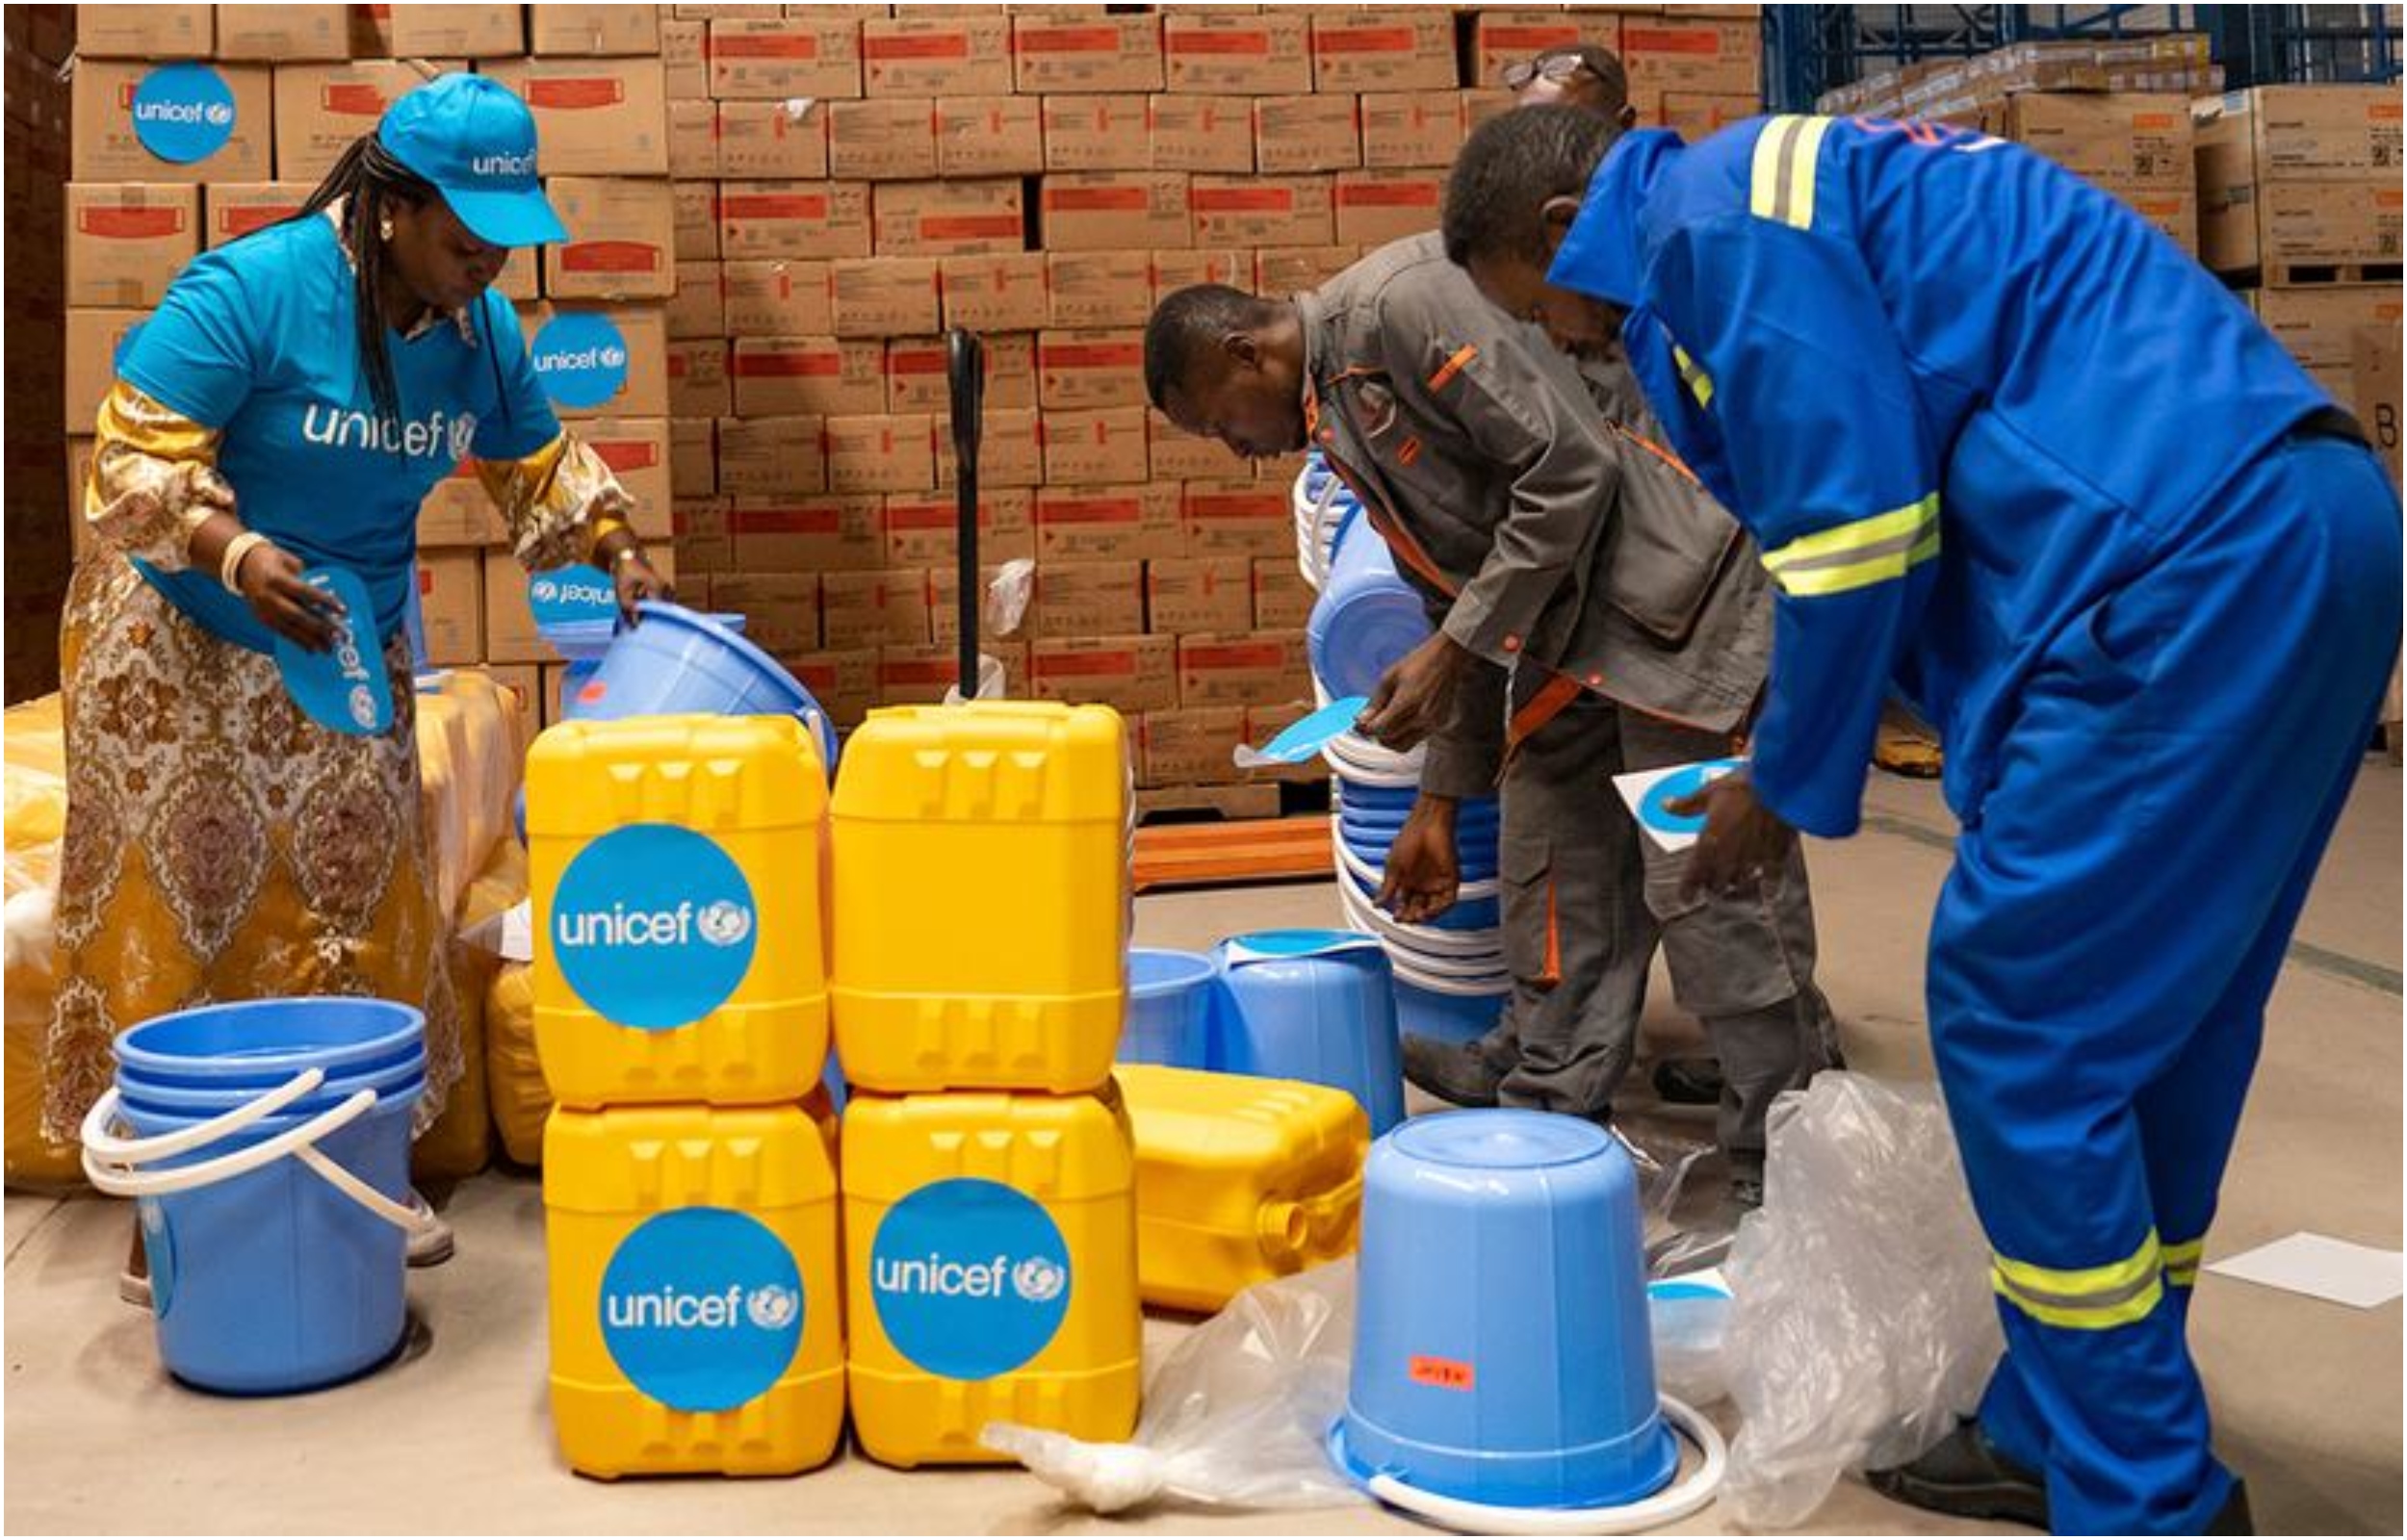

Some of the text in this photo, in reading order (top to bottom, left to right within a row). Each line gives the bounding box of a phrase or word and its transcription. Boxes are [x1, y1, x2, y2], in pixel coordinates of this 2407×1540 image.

[136, 99, 203, 123] unicef
[533, 346, 596, 372] unicef
[303, 403, 443, 459] unicef
[558, 901, 692, 946] unicef
[876, 1252, 1007, 1297] unicef
[608, 1284, 741, 1328] unicef
